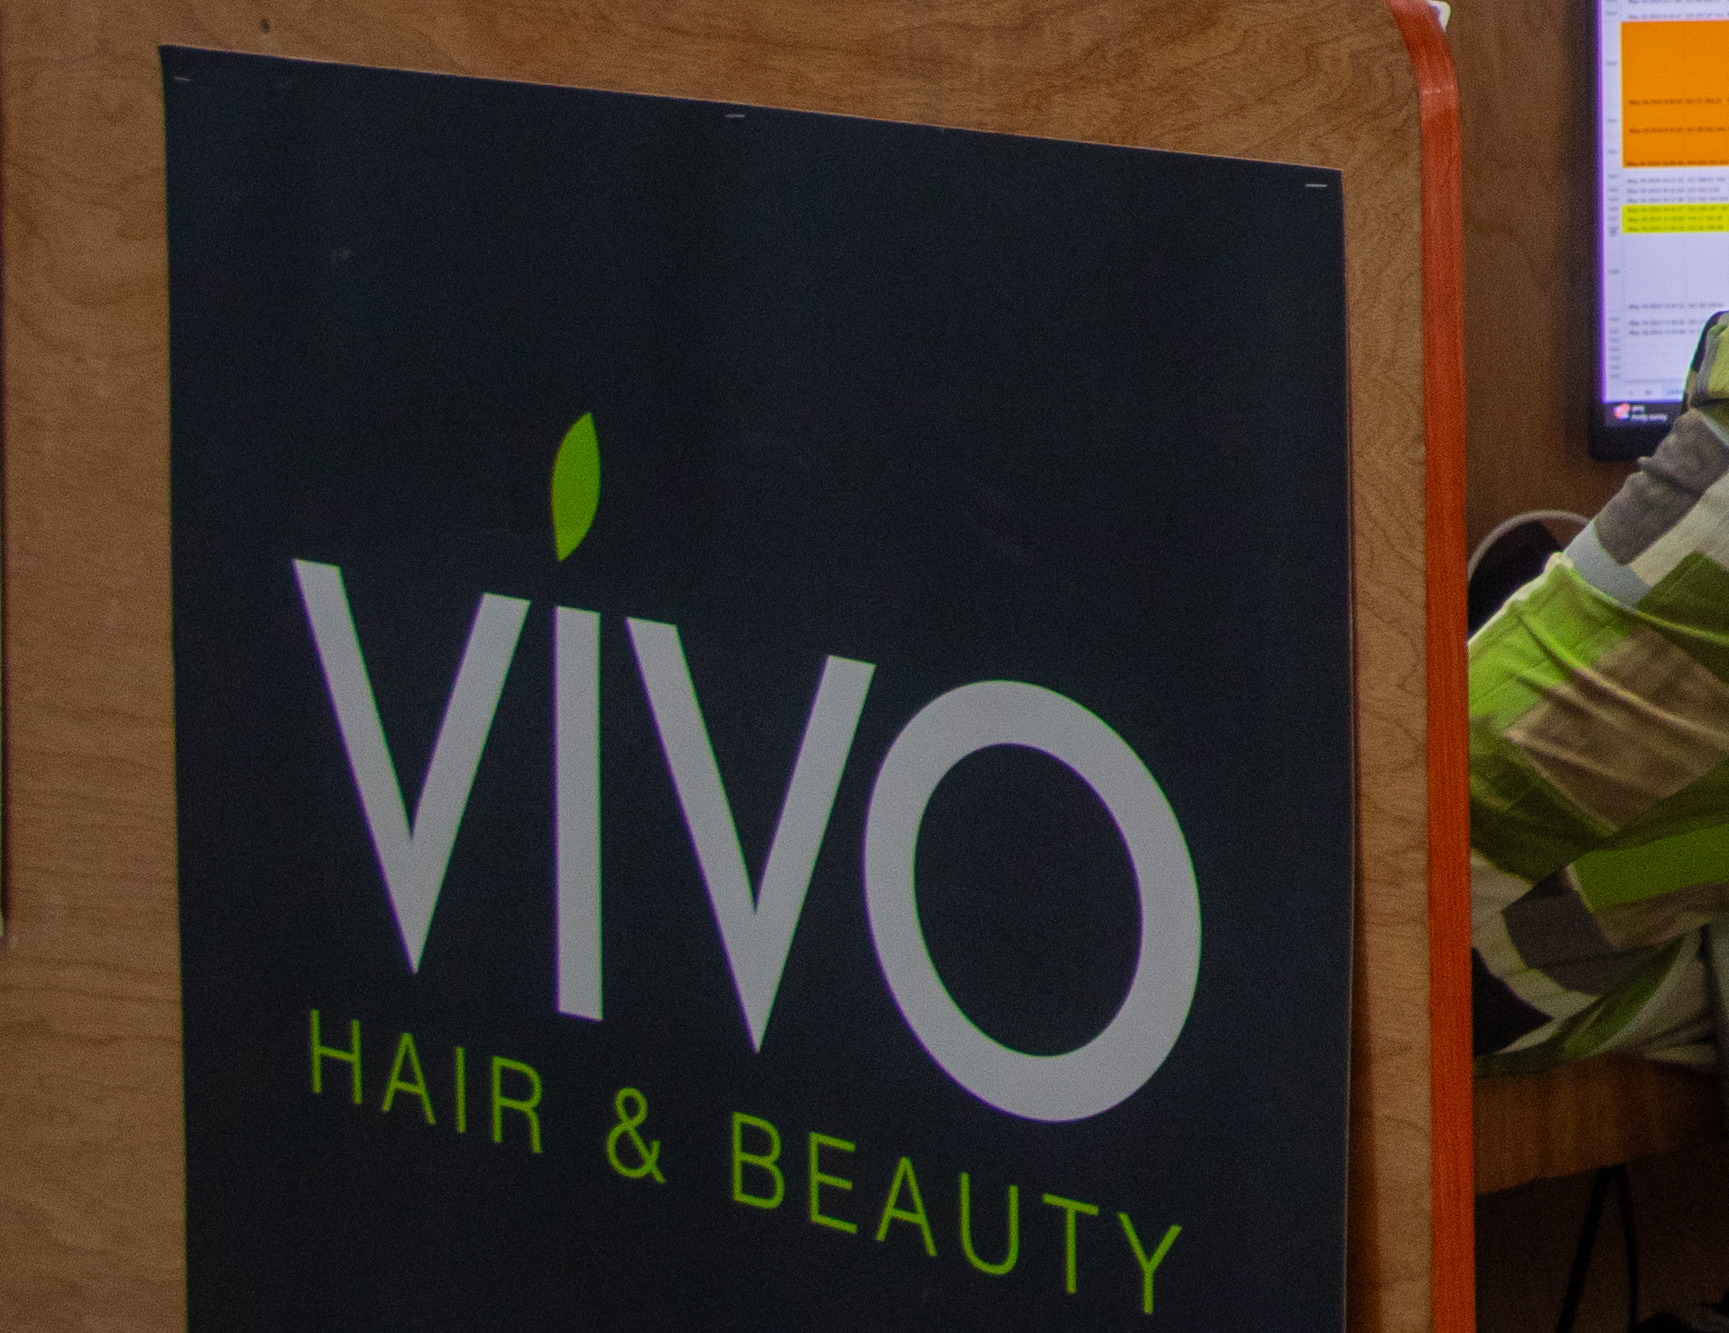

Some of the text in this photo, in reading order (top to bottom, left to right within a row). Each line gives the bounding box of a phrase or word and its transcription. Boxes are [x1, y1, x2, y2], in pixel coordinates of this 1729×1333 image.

[293, 558, 1202, 1122] VIVO
[309, 1007, 1183, 1315] HAIR & BEAUTY
